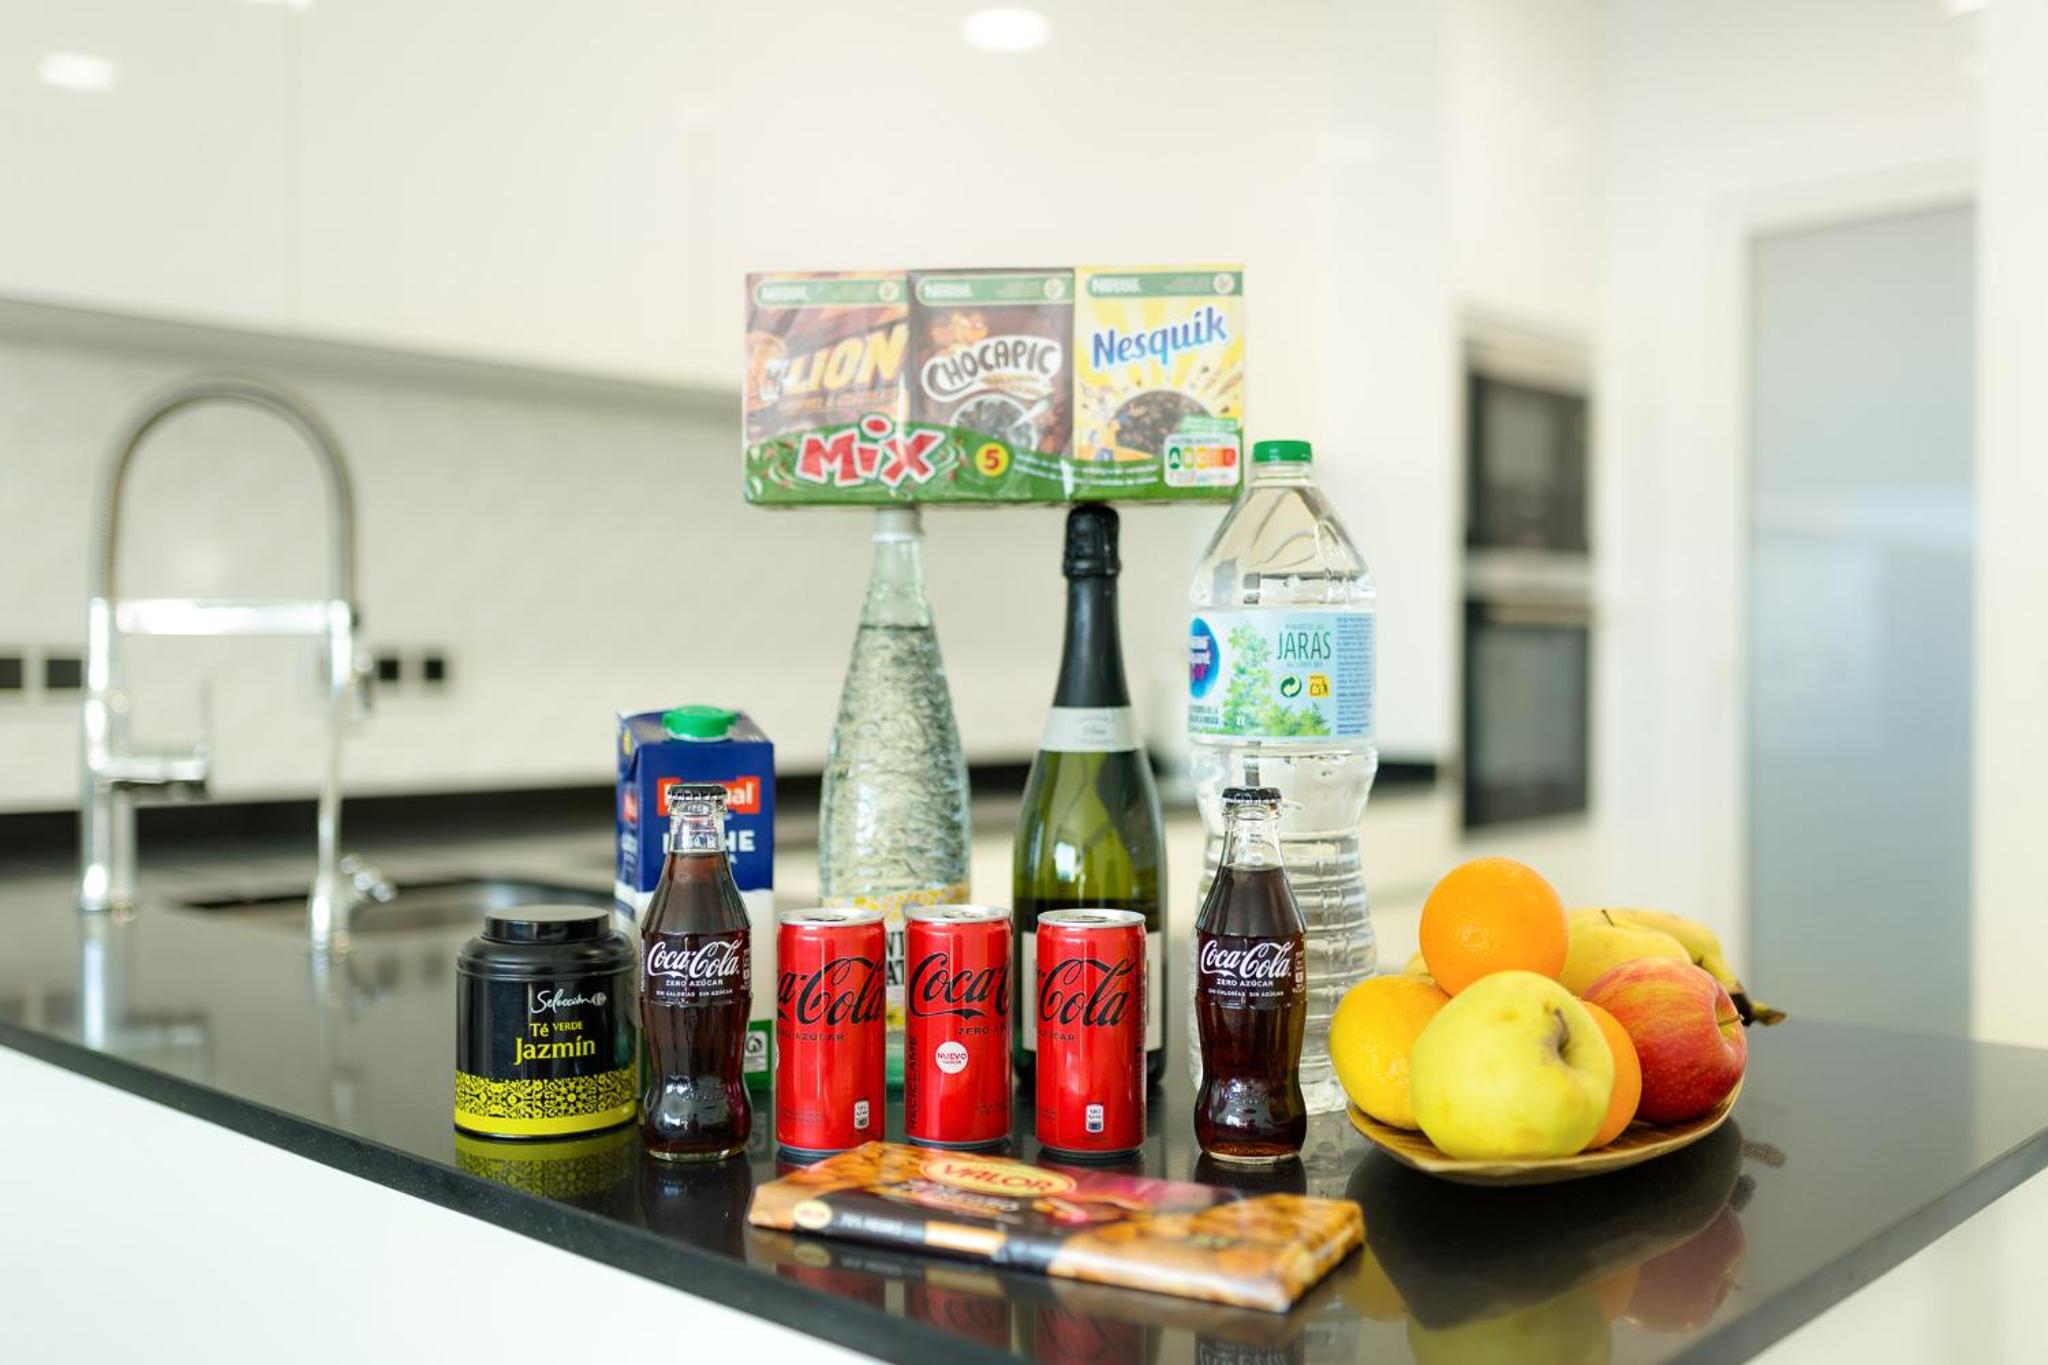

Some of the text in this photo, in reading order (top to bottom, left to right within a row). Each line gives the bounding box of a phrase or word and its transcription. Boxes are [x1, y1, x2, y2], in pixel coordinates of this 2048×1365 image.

[1093, 307, 1227, 368] Nesquik
[783, 322, 909, 396] LION
[926, 339, 1058, 397] CHOCAPIC
[984, 448, 1000, 469] 5
[1277, 631, 1331, 660] JARAS
[647, 939, 743, 978] Coca-Cola
[1201, 939, 1295, 979] Coca-Cola
[530, 988, 593, 1014] Selección
[529, 1020, 584, 1038] Té VERDE
[512, 1034, 596, 1066] Jazmín
[943, 1163, 1054, 1193] VALOR
